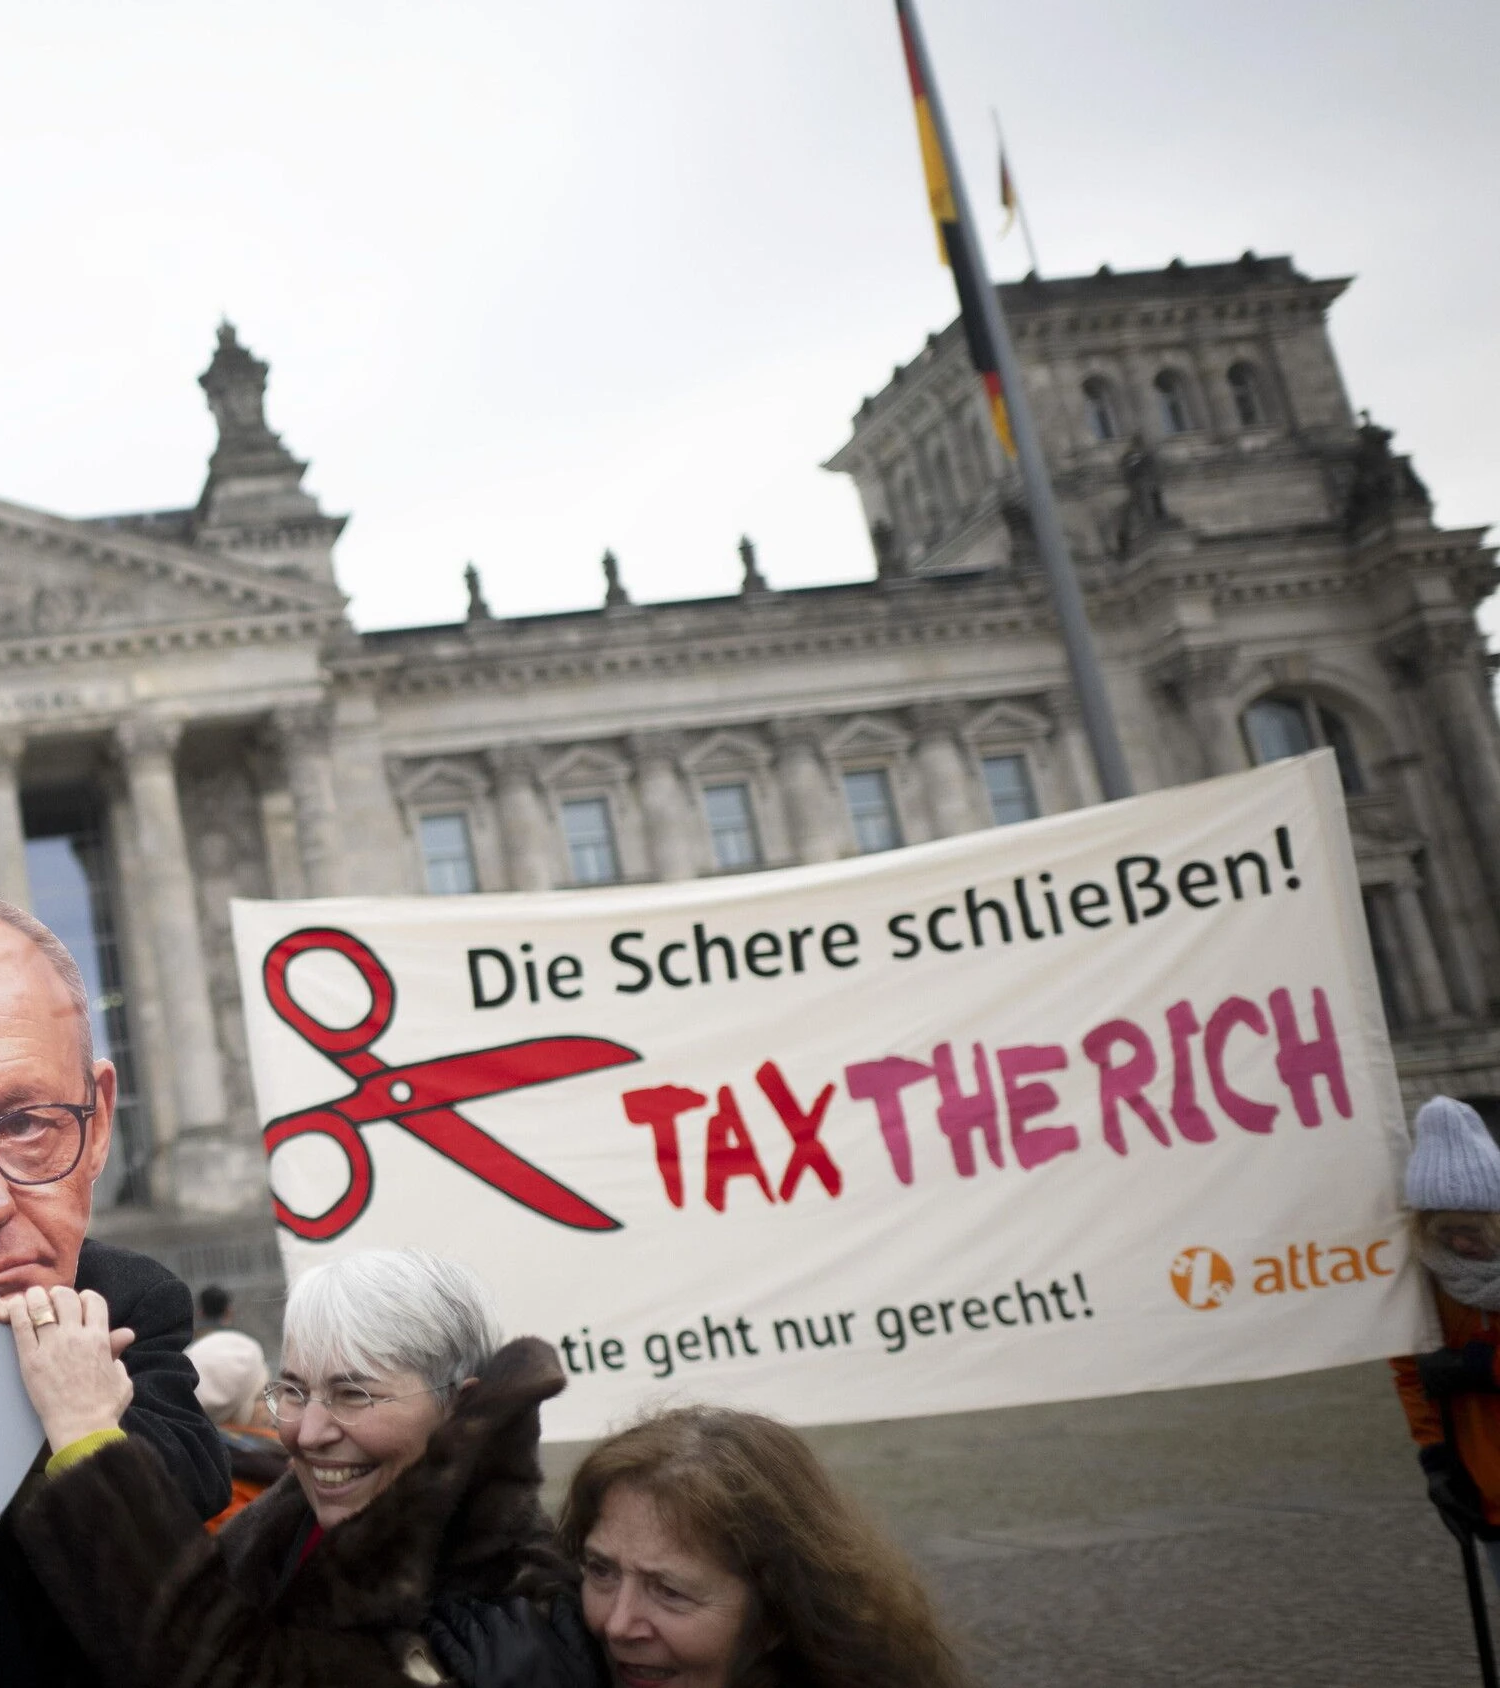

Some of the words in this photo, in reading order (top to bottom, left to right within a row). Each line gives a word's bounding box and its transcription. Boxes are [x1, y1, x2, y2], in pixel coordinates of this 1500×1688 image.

[467, 942, 584, 1009] Die
[610, 923, 860, 994] Schere
[887, 824, 1301, 959] schließen!
[622, 1060, 843, 1213] TAX
[845, 1040, 1080, 1186] THE
[1081, 986, 1354, 1156] RICH
[560, 1327, 626, 1374] tie
[644, 1314, 759, 1377] geht
[773, 1306, 857, 1351] nur
[875, 1272, 1096, 1352] gerecht!
[1252, 1238, 1396, 1296] attac
